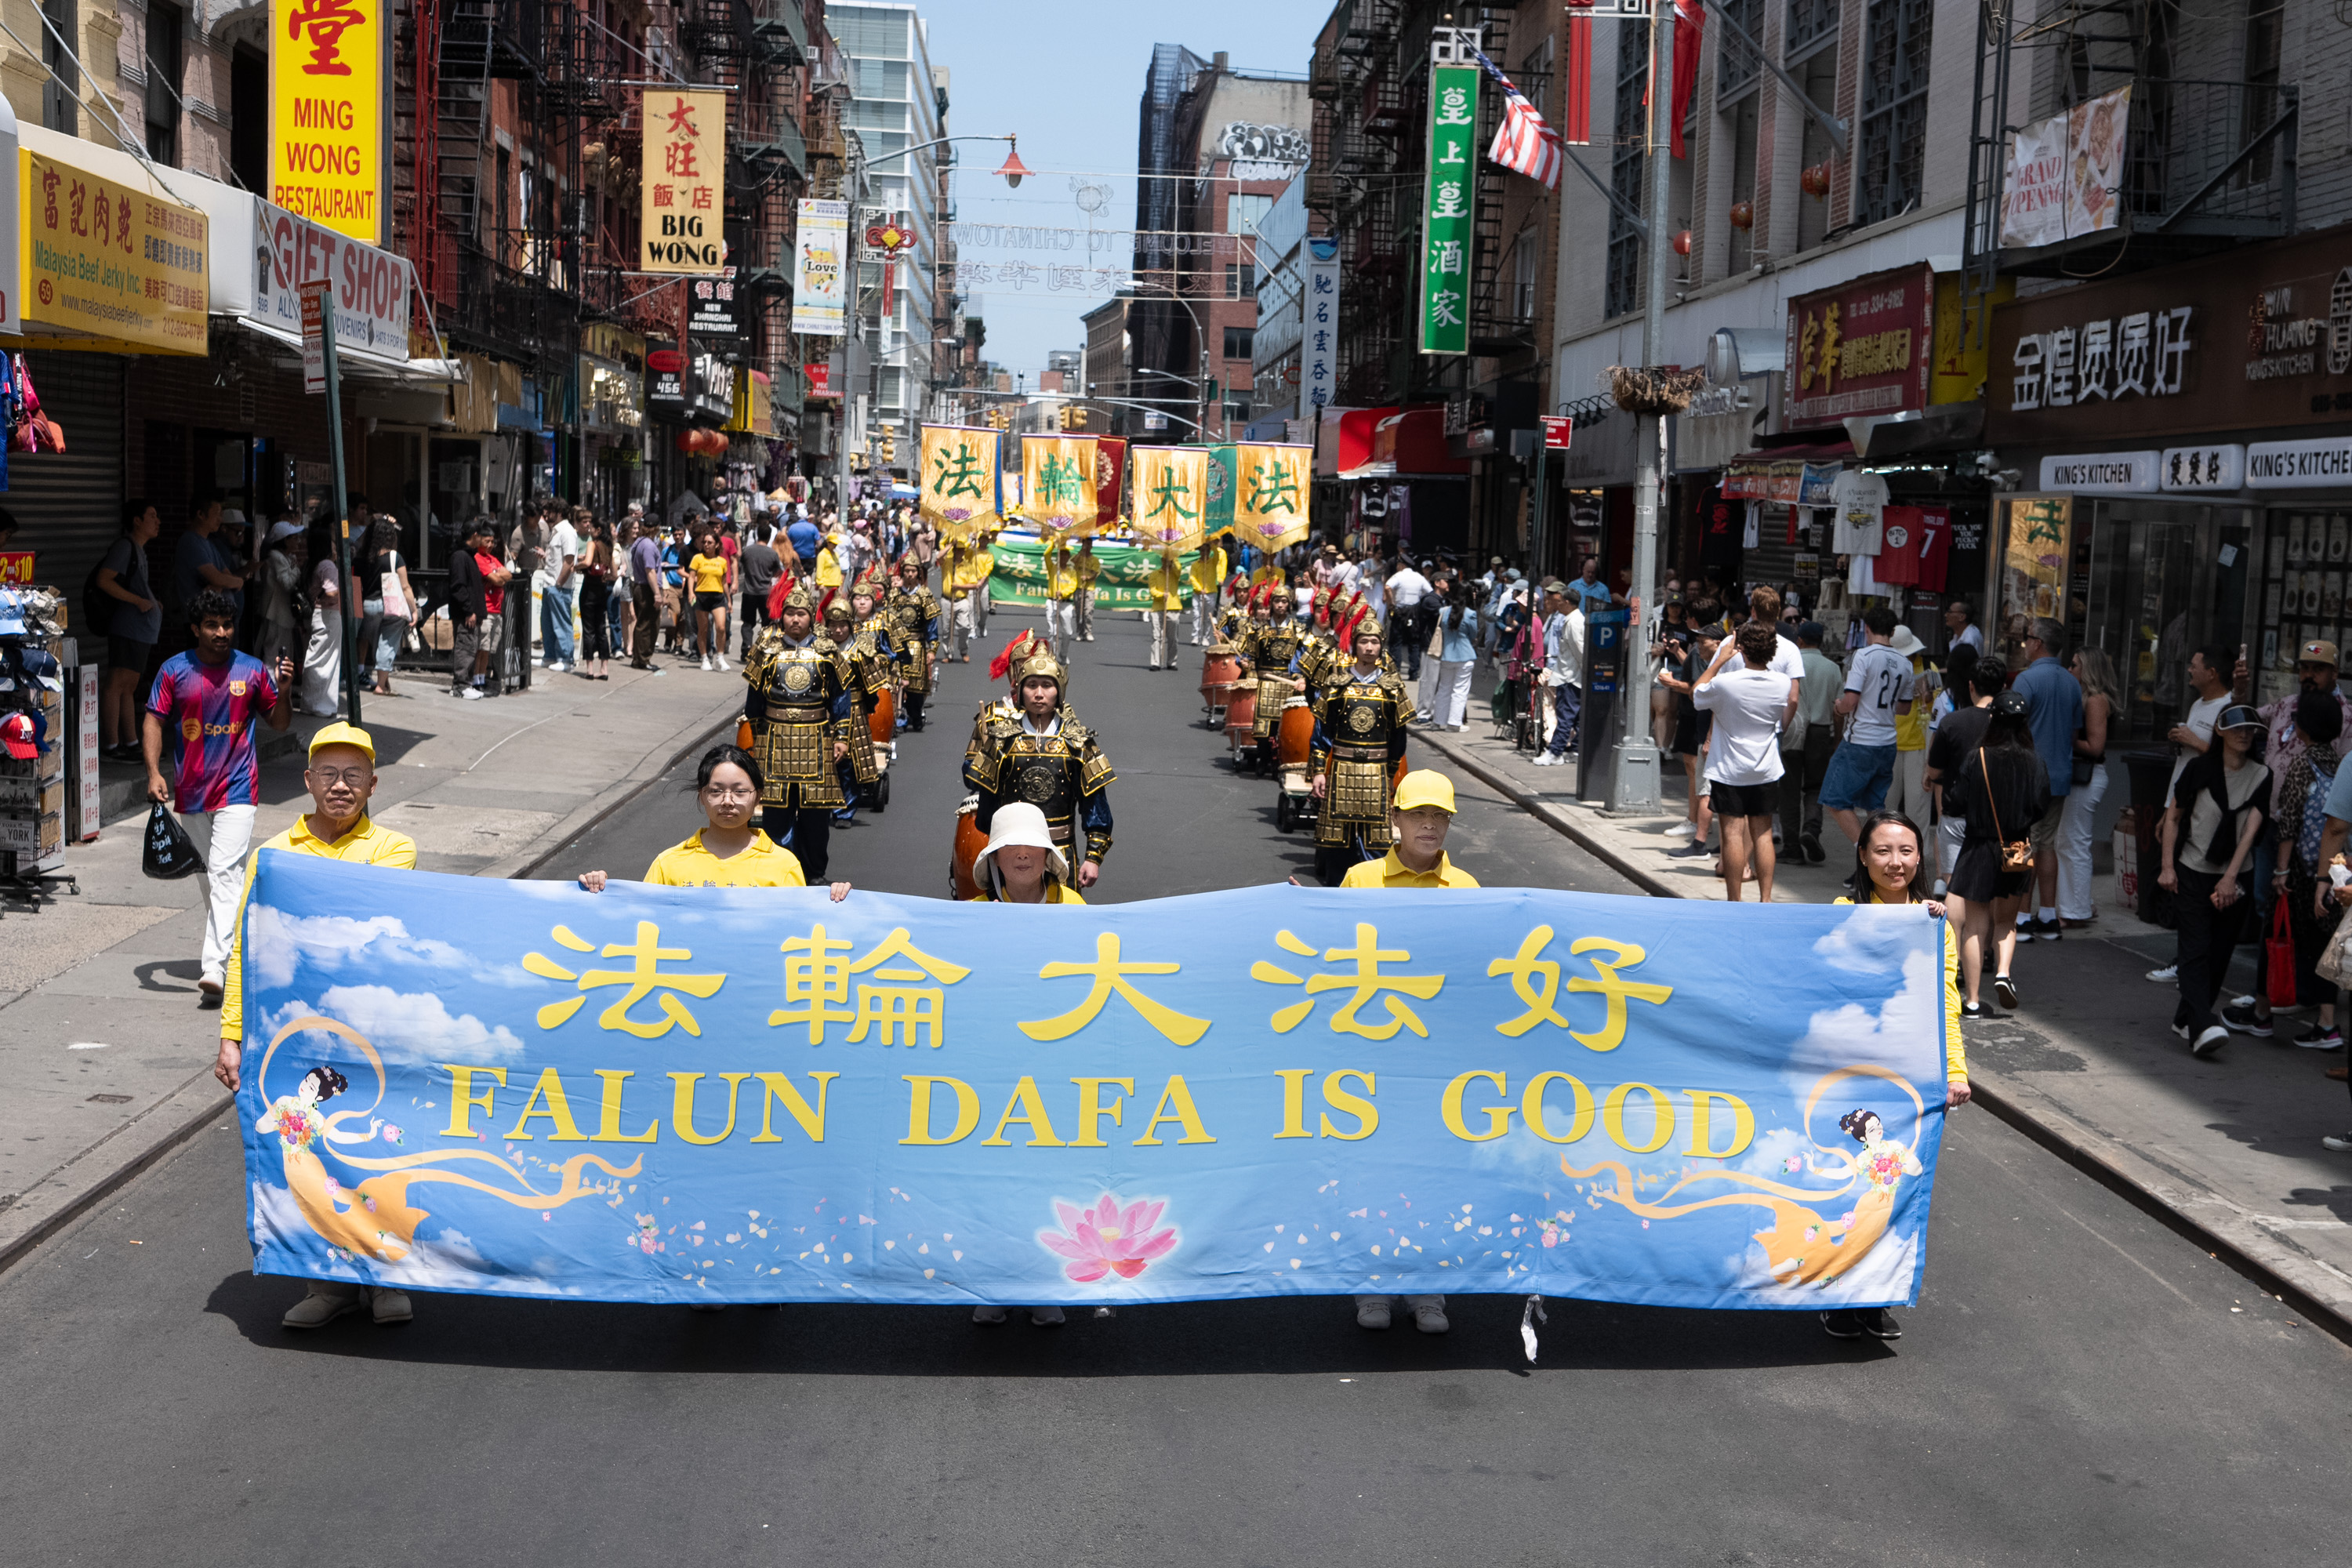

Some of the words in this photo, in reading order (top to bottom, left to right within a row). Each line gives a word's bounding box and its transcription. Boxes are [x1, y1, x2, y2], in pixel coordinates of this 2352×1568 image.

[294, 97, 354, 131] MING
[665, 96, 701, 177] 大旺
[286, 142, 361, 176] WONG
[2017, 157, 2061, 188] GRAND
[276, 185, 374, 220] RESTAURANT
[653, 183, 713, 209] 飯店
[662, 215, 702, 238] BIG
[648, 241, 717, 265] WONG
[35, 240, 76, 281] Malaysia
[79, 252, 100, 283] Beef
[101, 261, 125, 296] Jerky
[127, 267, 141, 295] Inc.
[274, 216, 336, 292] GIFT
[341, 243, 402, 322] SHOP
[807, 261, 837, 273] Love
[41, 285, 52, 299] 59
[301, 287, 307, 298] NO
[695, 281, 734, 300] 餐館
[61, 293, 153, 332] www.malaysiabeefjerky.com
[257, 296, 268, 313] 59B
[278, 296, 293, 319] ALL
[694, 312, 732, 322] SHANGHAI
[705, 303, 721, 312] NEW
[163, 317, 204, 341] 212-965-0796
[333, 313, 366, 340] OUVENIRS
[689, 321, 738, 332] RESTAURANT
[2265, 318, 2317, 352] HUANG
[303, 343, 310, 352] NO
[310, 340, 322, 351] PARKI
[390, 335, 399, 347] FOR
[2011, 306, 2192, 411] 金煌煲煲好
[2274, 352, 2314, 377] KITCHEN
[657, 382, 681, 394] 456
[934, 444, 985, 500] 法
[2054, 464, 2085, 485] KING'S
[2088, 463, 2132, 484] KITCHEN
[2251, 452, 2296, 477] KING'S
[2299, 450, 2352, 475] KITCHE
[1035, 452, 1087, 506] 輪
[1246, 461, 1298, 514] 法
[1145, 466, 1200, 519] 大
[1920, 528, 1936, 558] 7
[0, 557, 8, 583] 2
[15, 555, 33, 582] $10
[1116, 587, 1131, 601] Is
[1600, 627, 1612, 645] P
[1878, 670, 1902, 711] 21
[8, 829, 30, 842] YORK
[521, 920, 1675, 1052] 法輪大法好
[439, 1063, 840, 1147] FALUN
[898, 1073, 1217, 1148] DAFA
[1272, 1067, 1380, 1142] IS
[1441, 1069, 1756, 1159] GOOD
